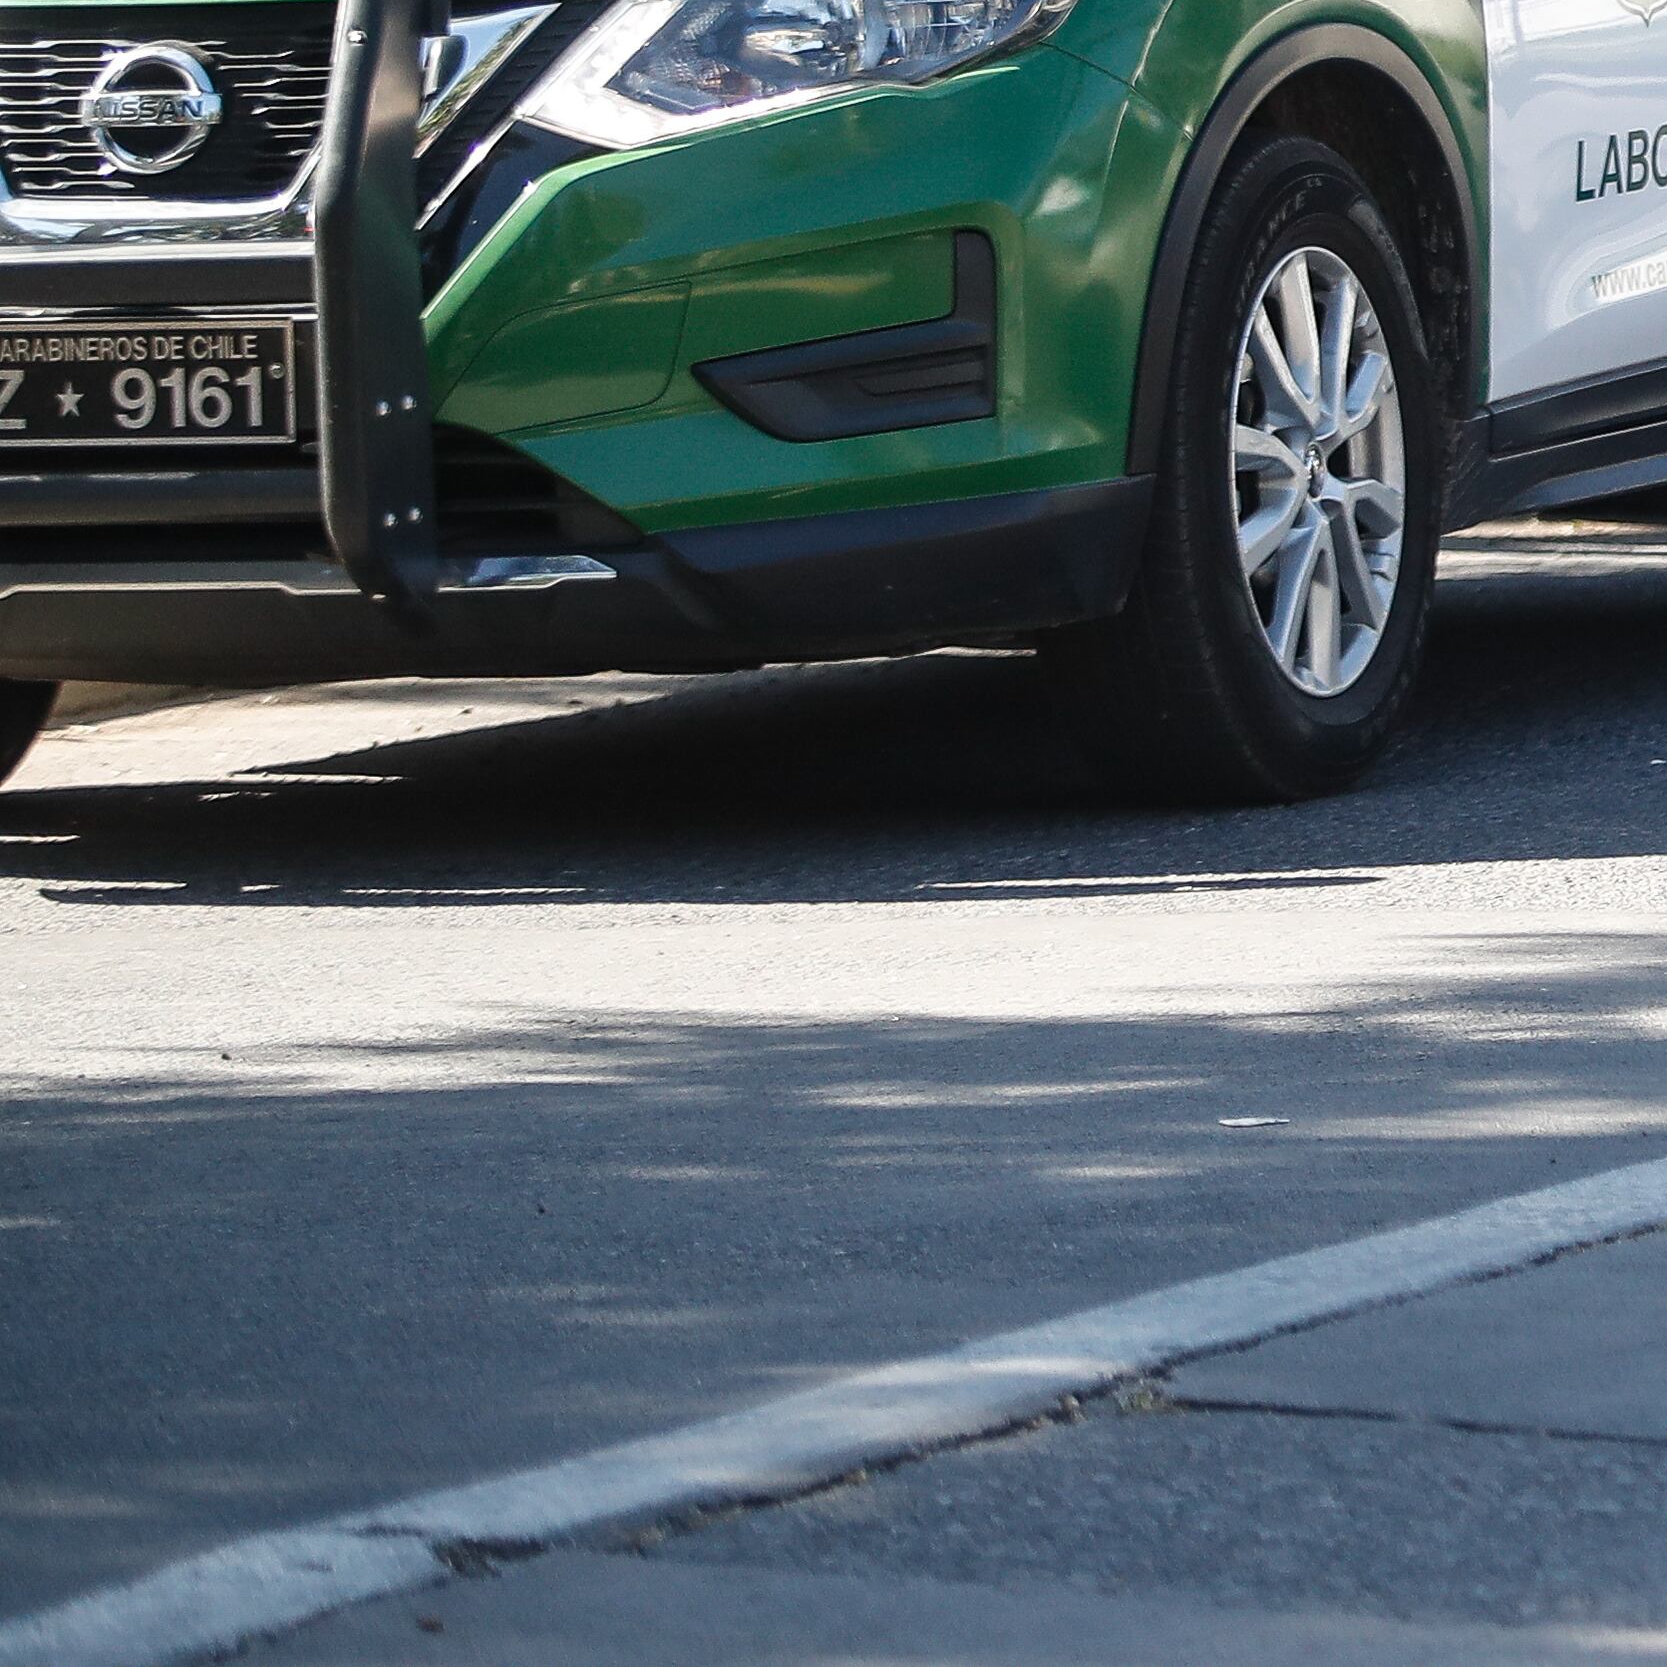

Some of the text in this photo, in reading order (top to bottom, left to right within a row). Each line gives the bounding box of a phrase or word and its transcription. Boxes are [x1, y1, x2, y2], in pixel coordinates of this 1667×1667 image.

[153, 336, 185, 360] DE
[189, 335, 258, 359] CHILE
[110, 366, 263, 429] 9161
